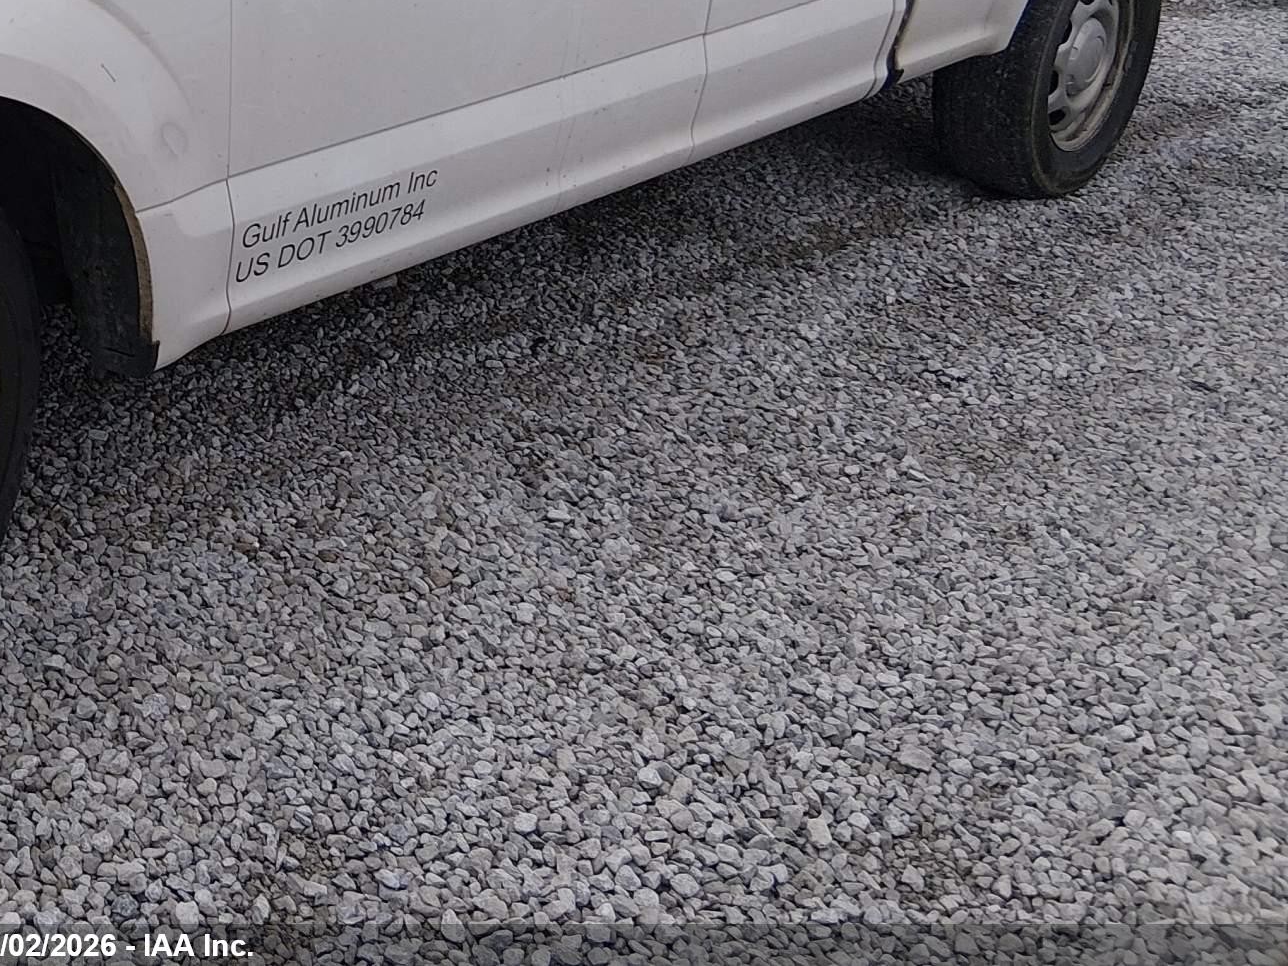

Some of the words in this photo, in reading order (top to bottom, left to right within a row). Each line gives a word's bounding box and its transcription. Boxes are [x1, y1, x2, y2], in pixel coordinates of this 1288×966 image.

[235, 252, 270, 283] US
[278, 230, 333, 269] DOT
[335, 199, 426, 248] 3990784
[242, 211, 293, 248] Gulf
[292, 181, 401, 232] Aluminum
[407, 169, 439, 194] Inc
